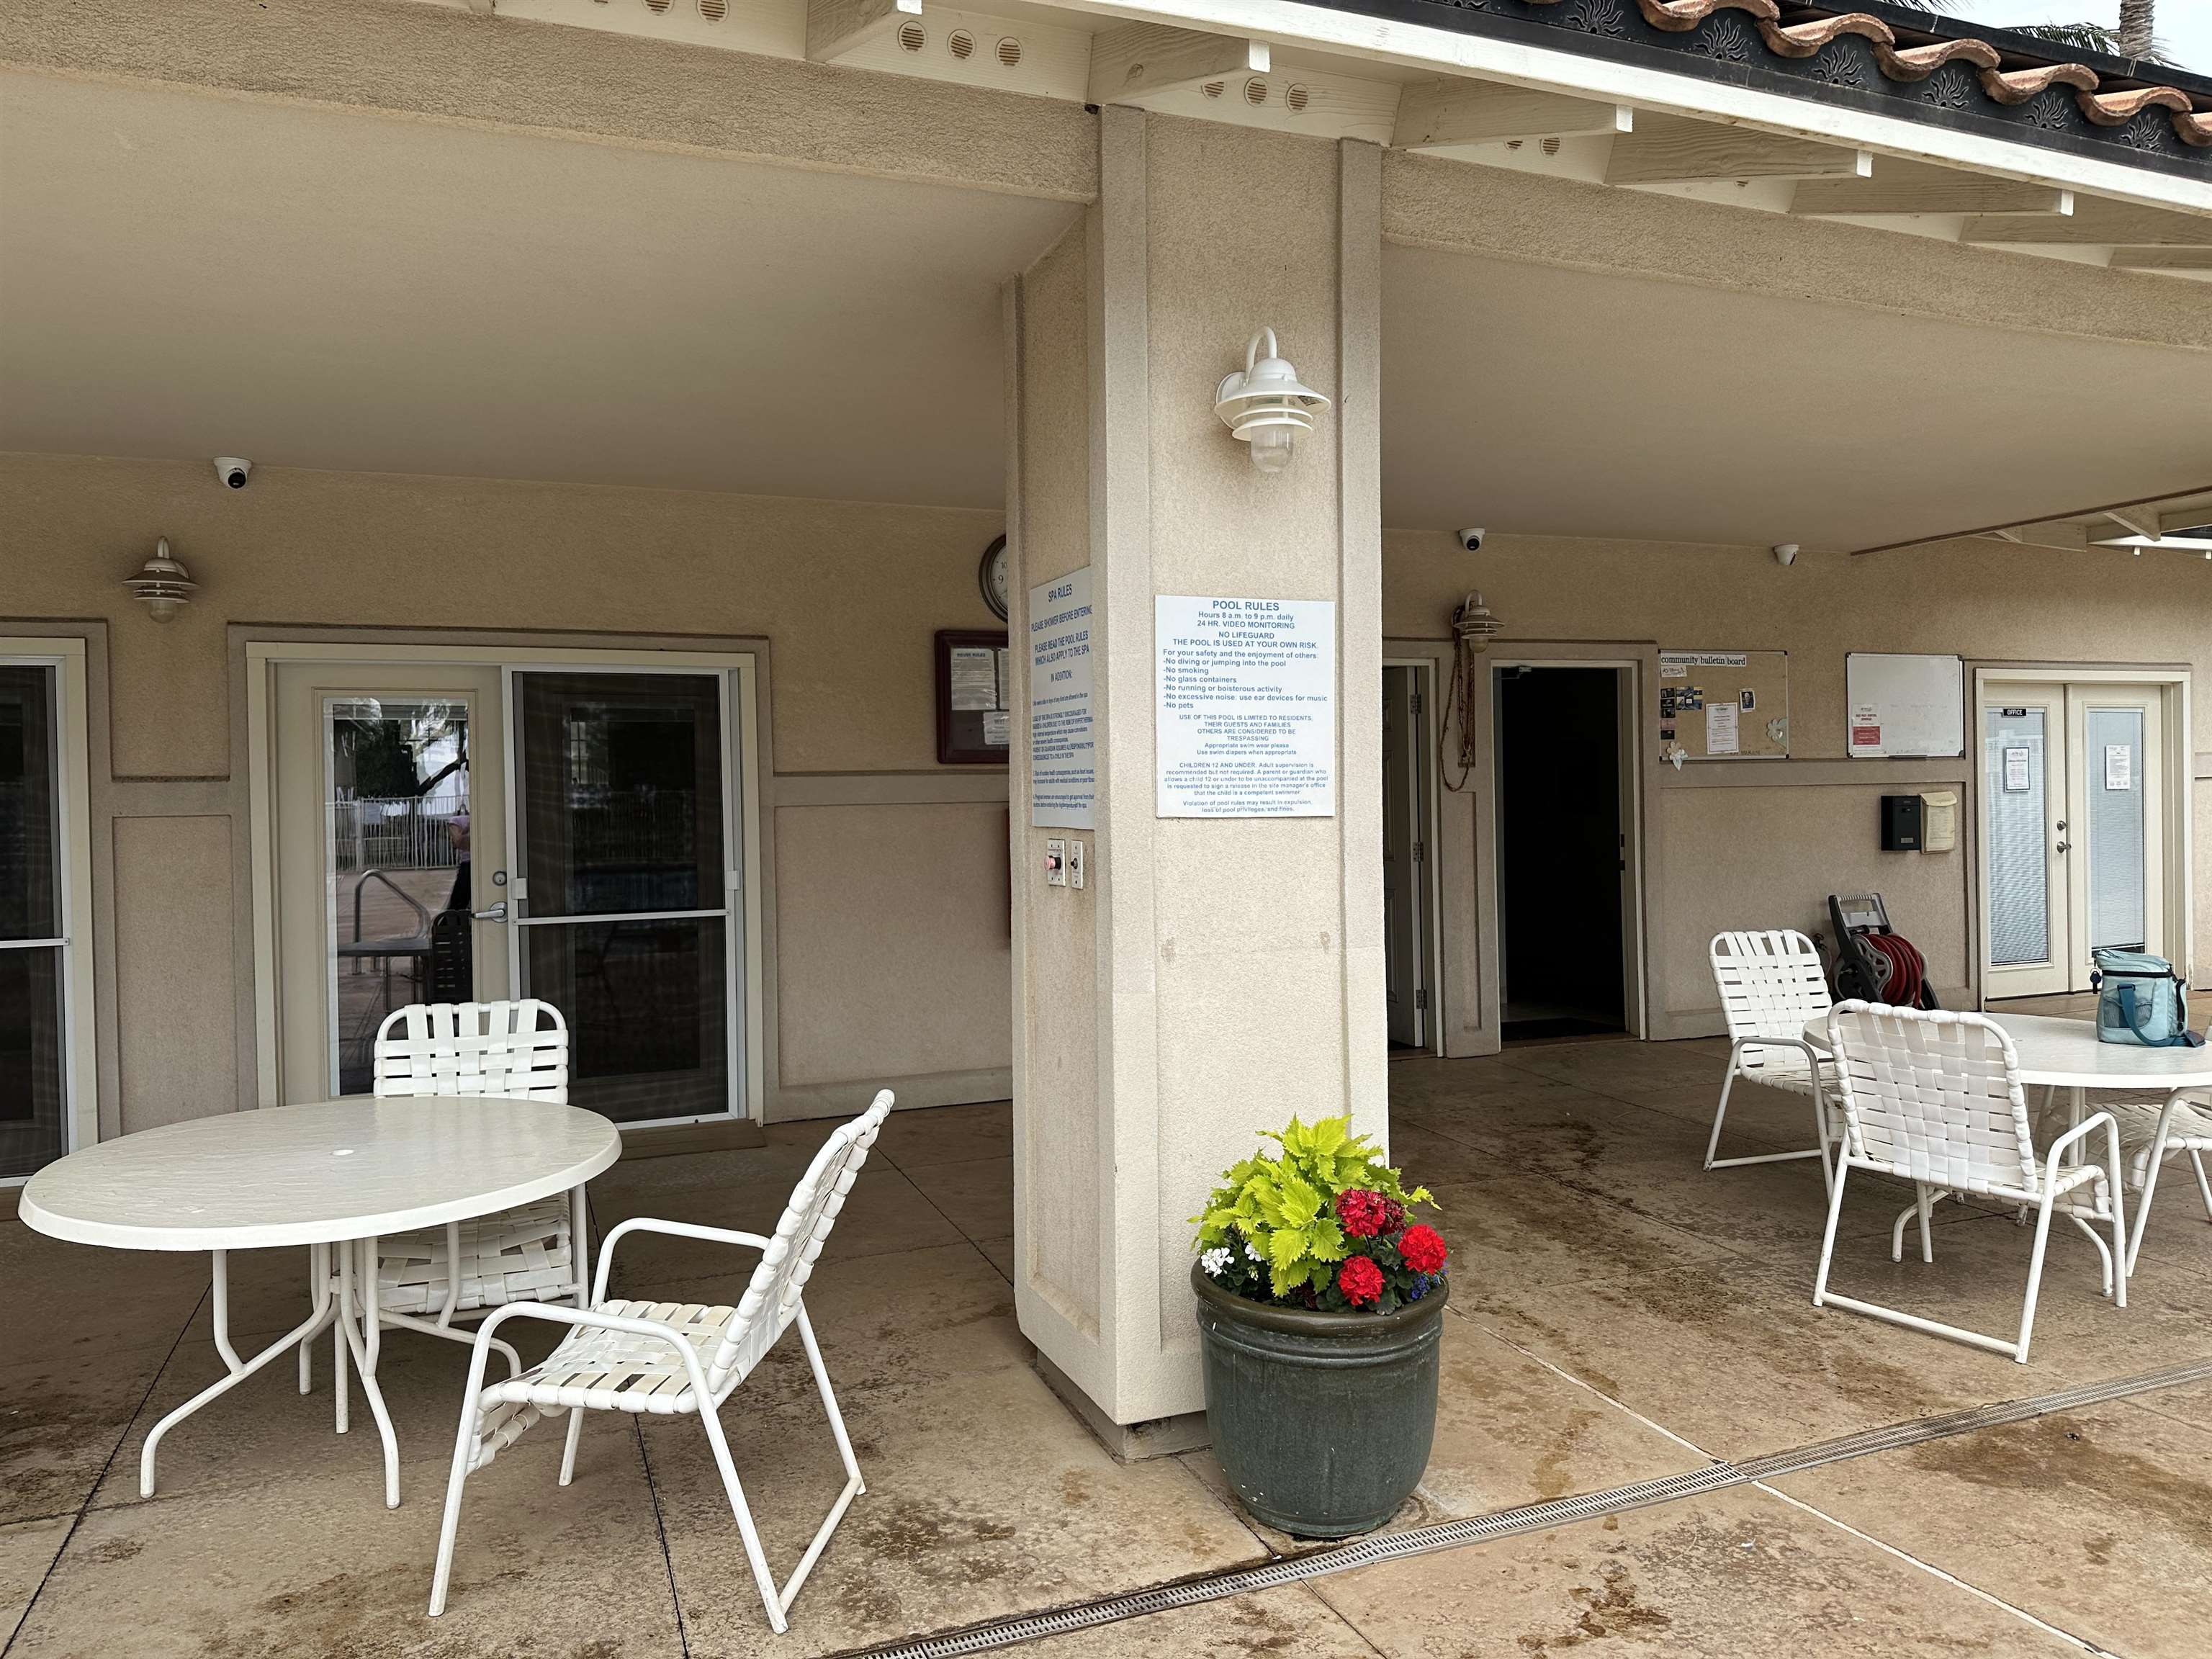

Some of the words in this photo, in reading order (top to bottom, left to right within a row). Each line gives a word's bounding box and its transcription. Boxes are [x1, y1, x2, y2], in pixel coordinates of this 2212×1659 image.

[998, 575, 1004, 583] 9
[1048, 590, 1057, 602] SPA
[1058, 584, 1072, 599] RULES
[1213, 600, 1241, 610] POOL
[1245, 601, 1279, 611] RULES
[1031, 620, 1043, 632] PLEASE
[1043, 616, 1058, 628] SHOWER
[1059, 611, 1073, 623] BEFORE
[1277, 613, 1293, 621] daily
[1035, 642, 1047, 653] PLEASE
[1048, 640, 1057, 649] READ
[1065, 634, 1075, 644] POOL
[1076, 631, 1088, 641] RULES
[1047, 653, 1055, 662] ALSO
[1056, 650, 1067, 660] APPLY
[1068, 648, 1073, 657] TO
[1081, 644, 1089, 654] SPA
[1196, 649, 1217, 657] safety
[1247, 650, 1283, 659] enjoyment
[1178, 667, 1208, 675] smoking
[1051, 673, 1054, 682] IN
